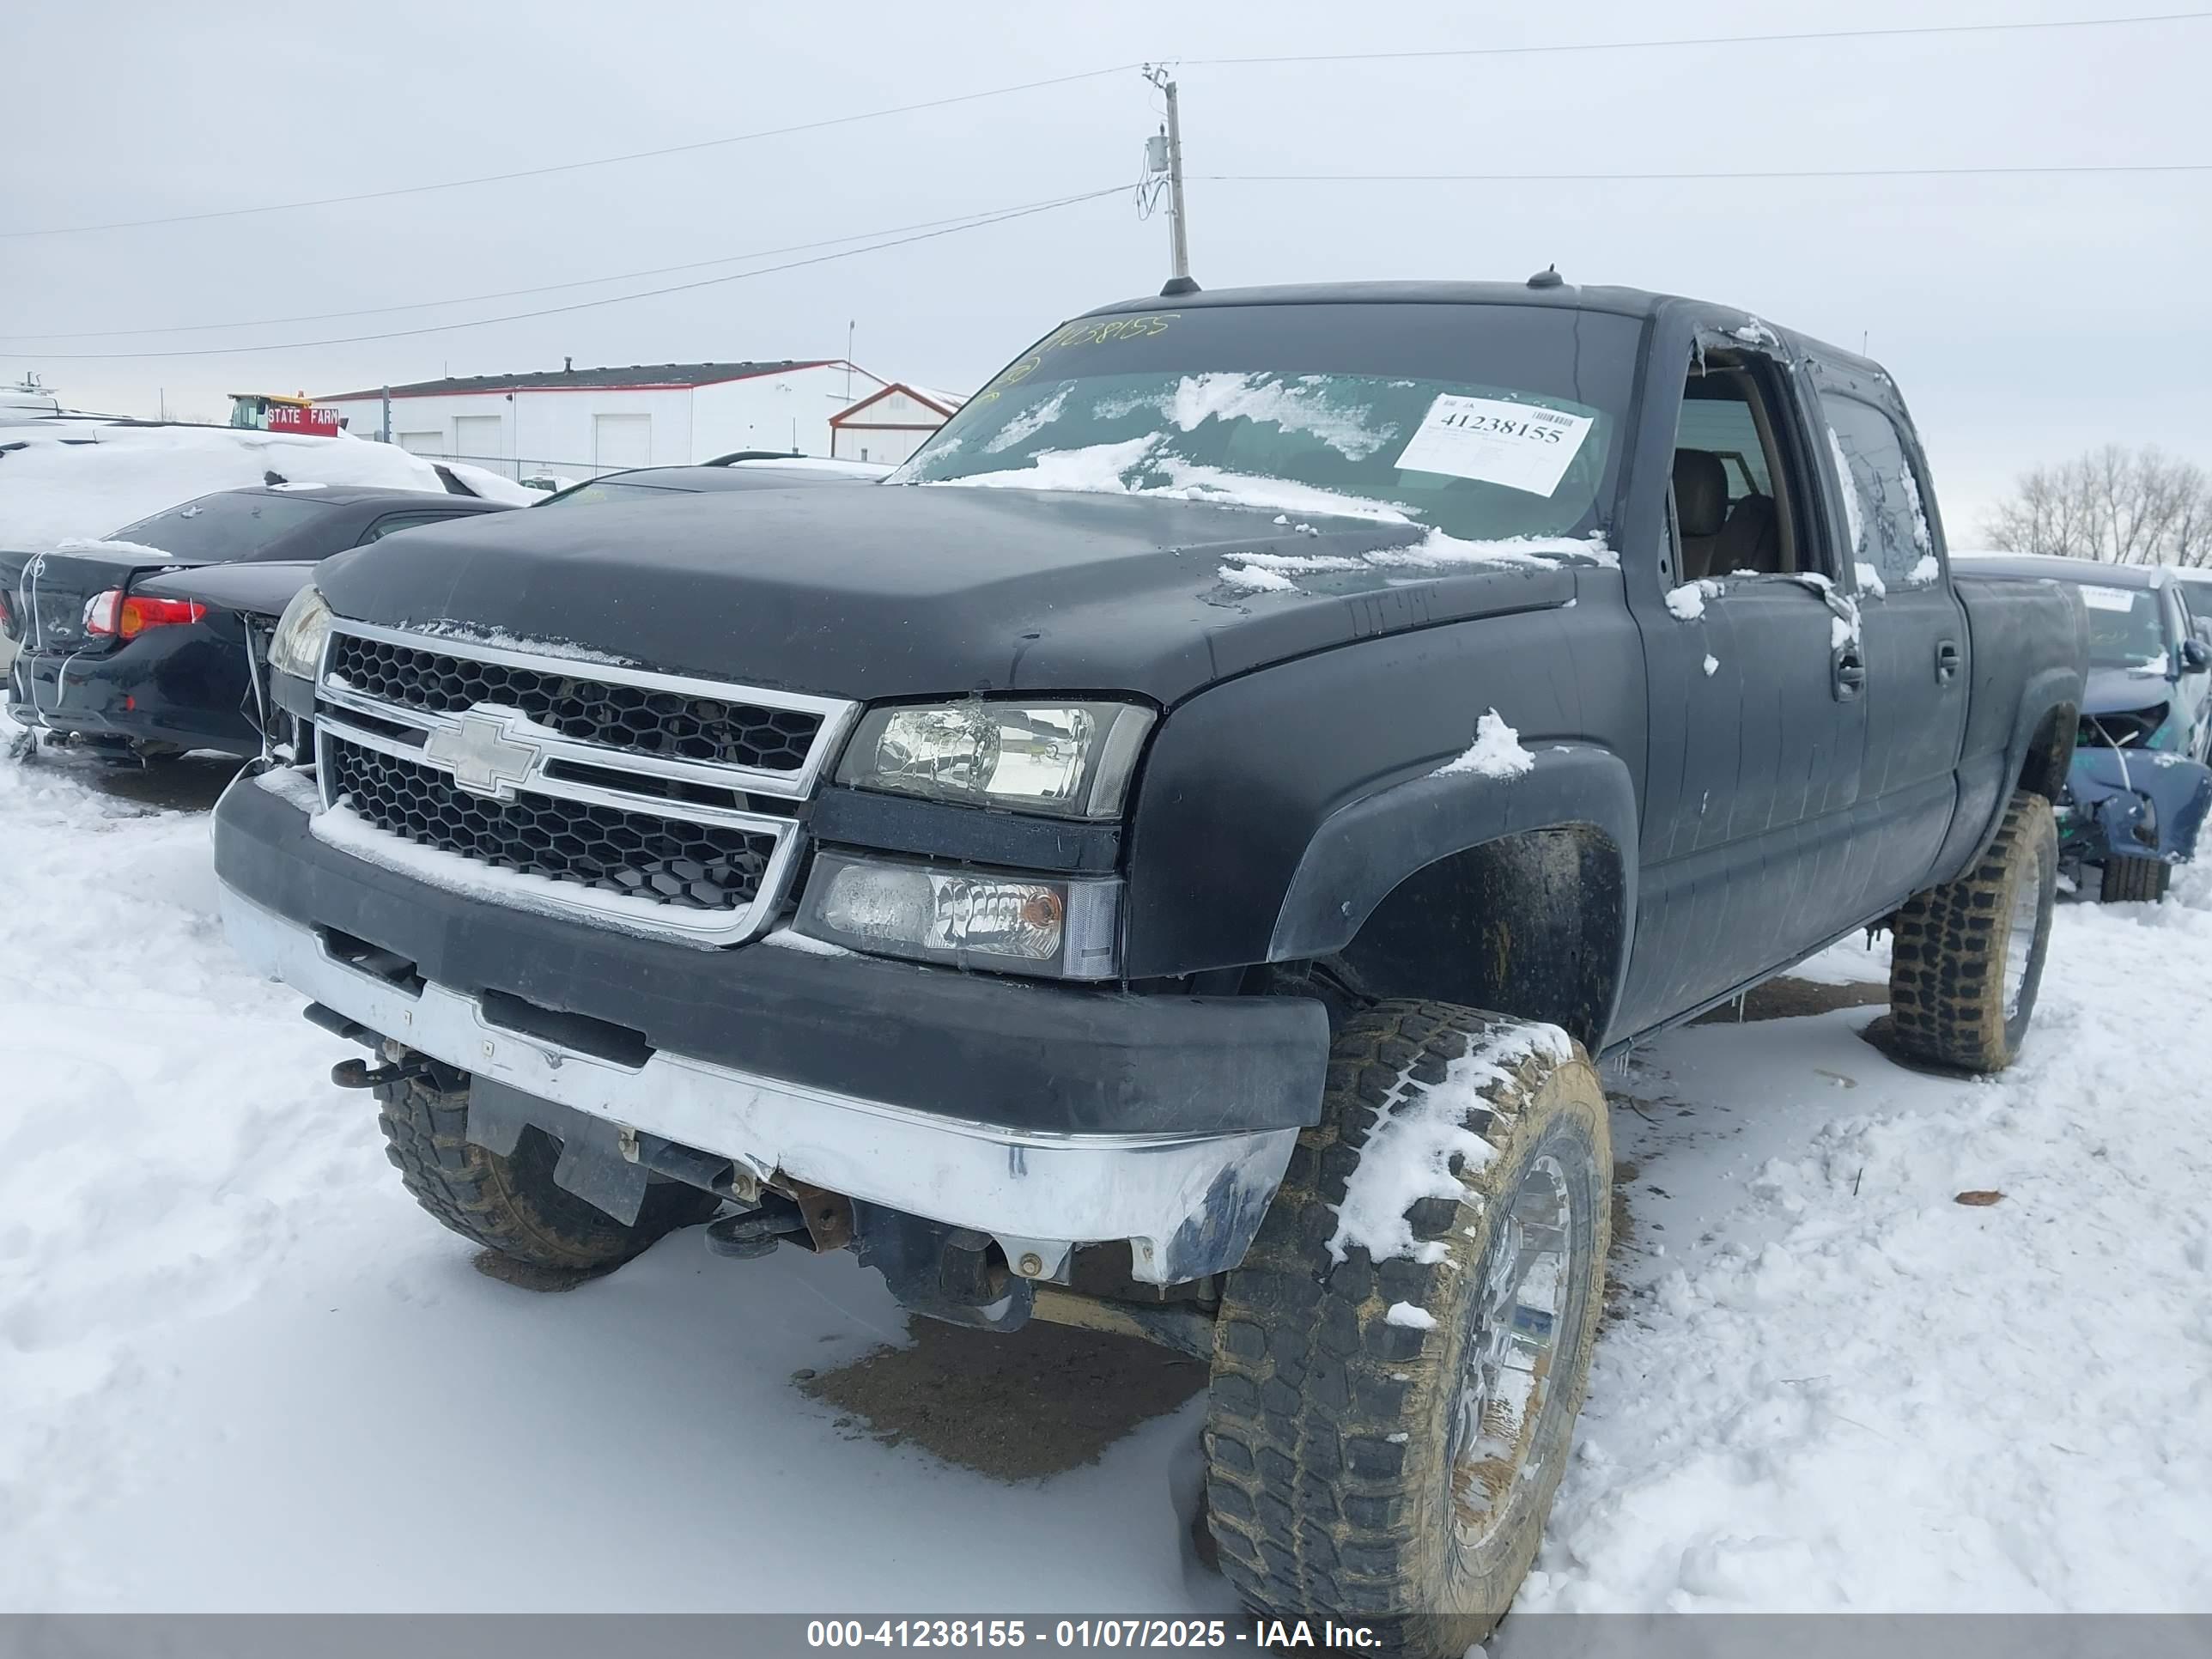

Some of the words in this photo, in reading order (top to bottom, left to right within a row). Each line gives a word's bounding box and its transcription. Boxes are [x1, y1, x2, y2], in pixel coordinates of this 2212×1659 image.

[268, 408, 301, 423] STATE
[311, 409, 338, 425] FARM
[1440, 412, 1565, 445] 41238155
